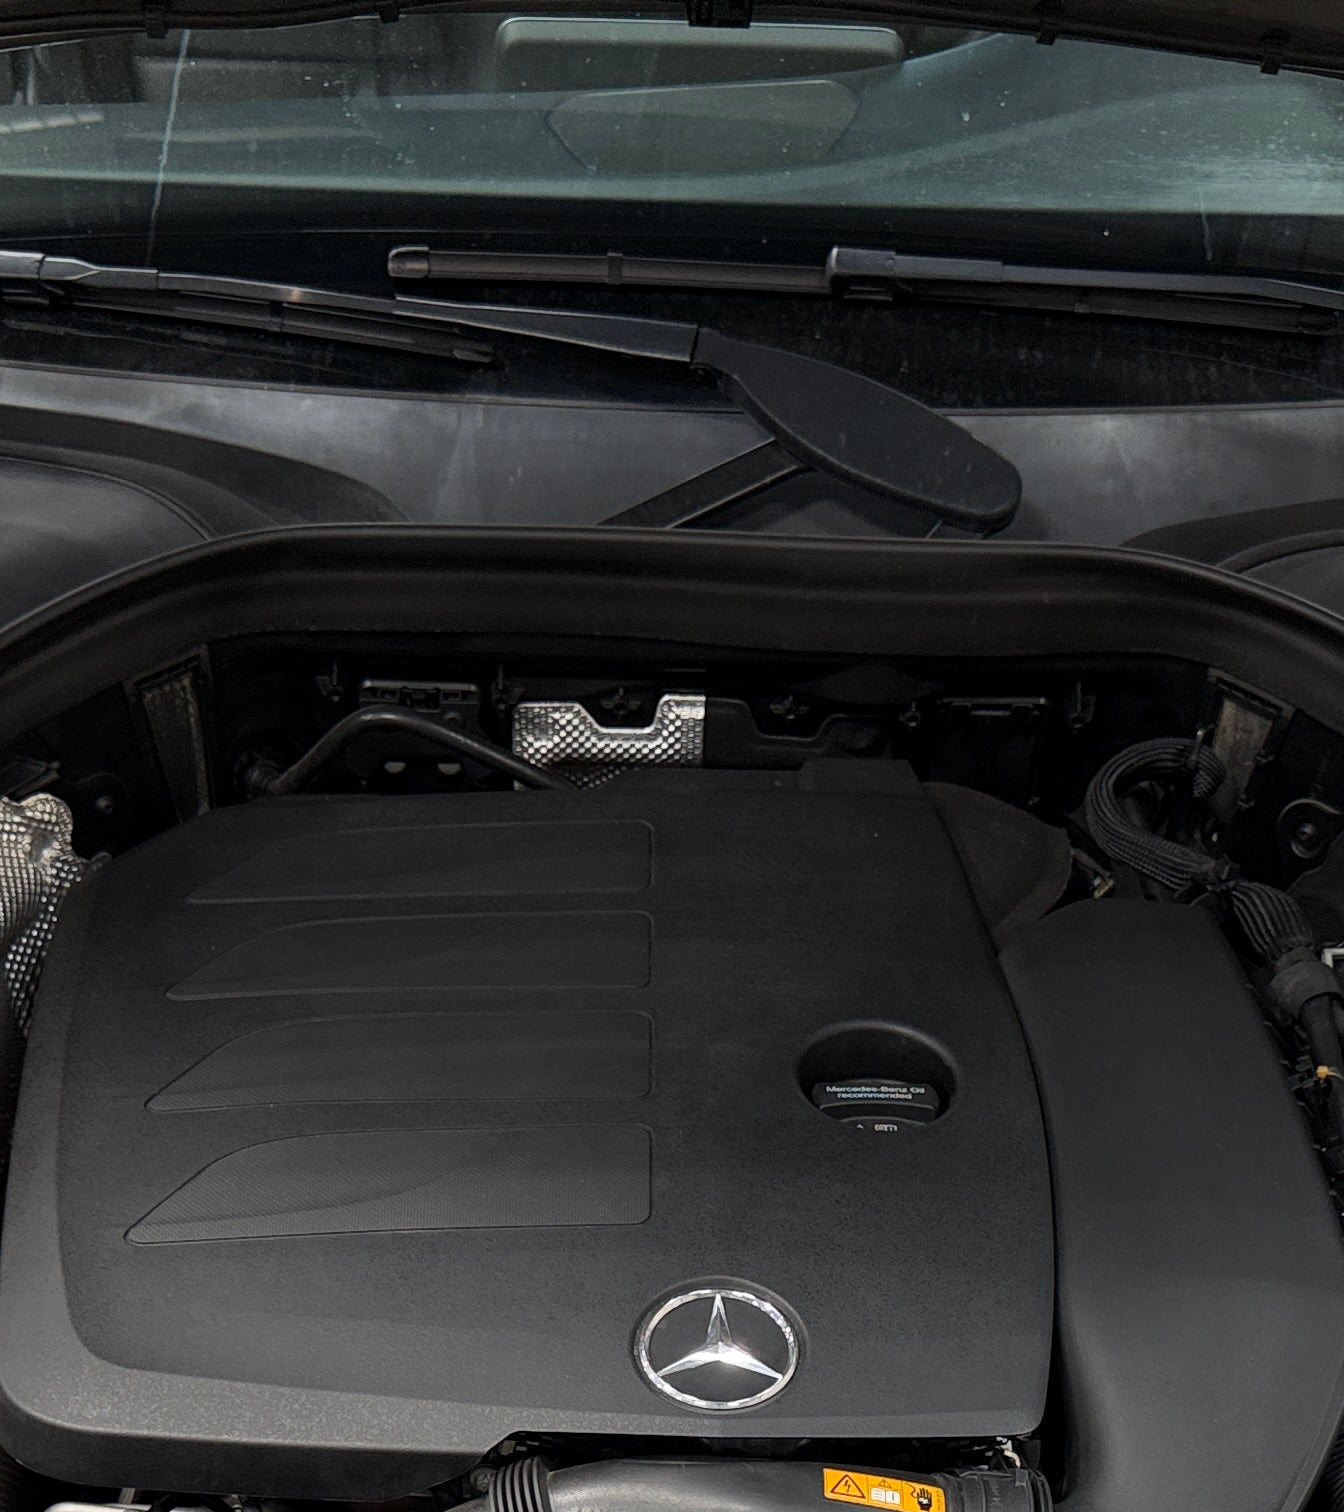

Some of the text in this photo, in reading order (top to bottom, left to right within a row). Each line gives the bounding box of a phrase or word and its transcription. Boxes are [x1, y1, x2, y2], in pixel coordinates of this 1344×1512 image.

[825, 1085, 926, 1094] Mercedes-Benz Oil
[836, 1092, 913, 1100] recommended
